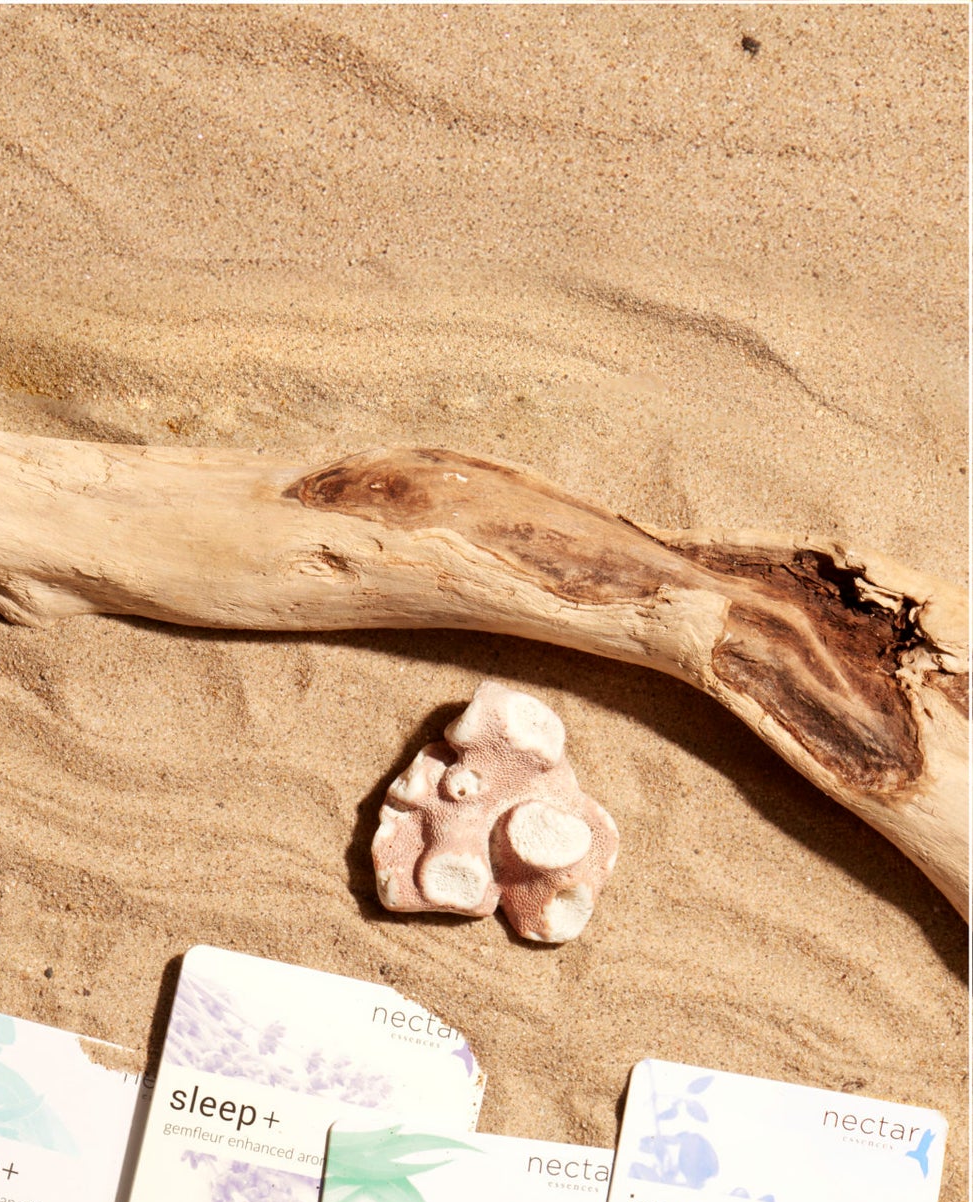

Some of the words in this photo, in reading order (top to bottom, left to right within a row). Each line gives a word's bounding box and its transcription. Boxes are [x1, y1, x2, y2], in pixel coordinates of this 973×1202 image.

[163, 1122, 226, 1145] gemfleur
[227, 1136, 295, 1160] enhanced
[822, 1110, 920, 1142] nectar
[528, 1155, 610, 1182] necta
